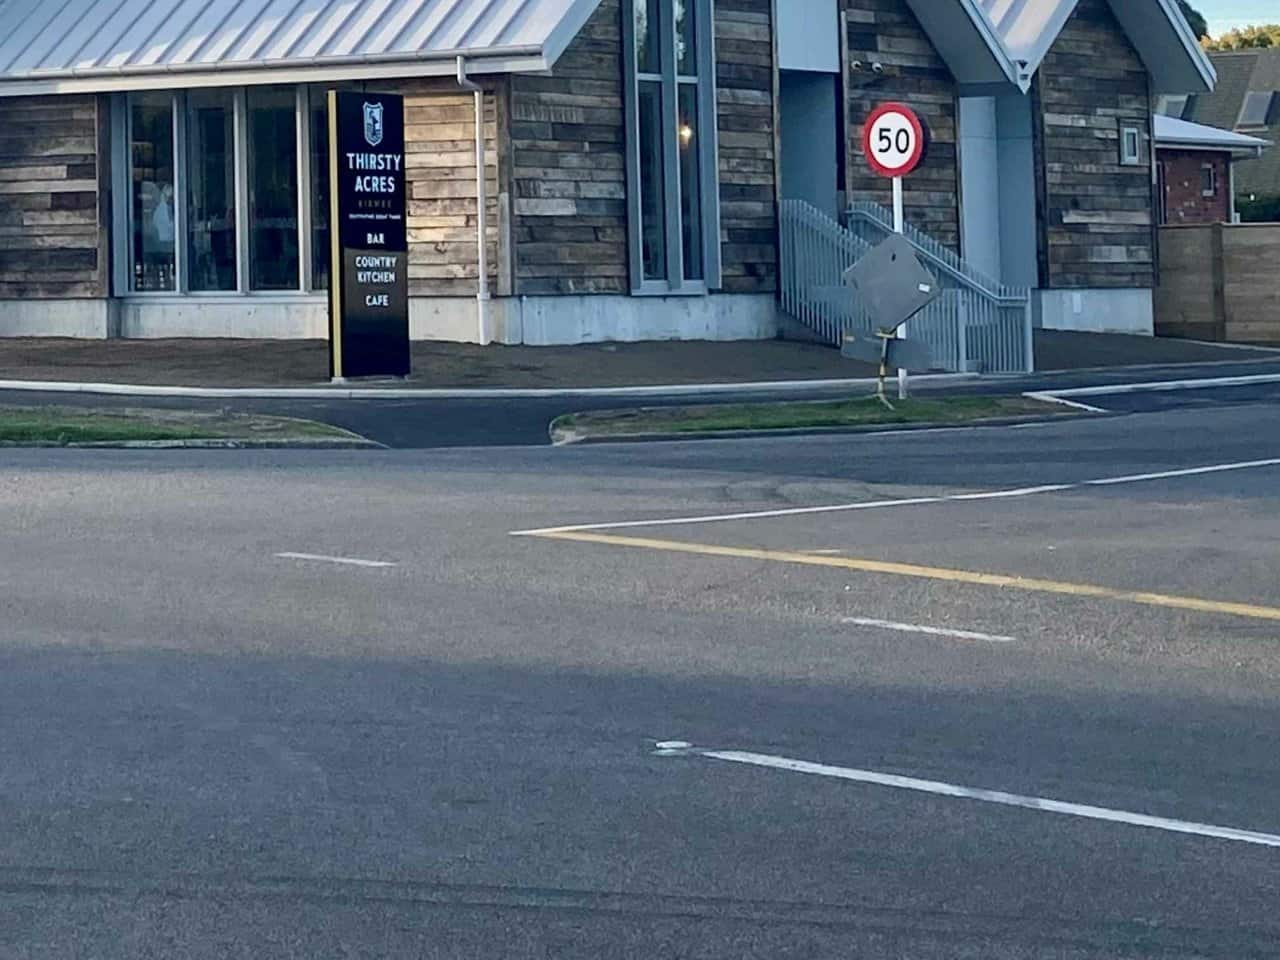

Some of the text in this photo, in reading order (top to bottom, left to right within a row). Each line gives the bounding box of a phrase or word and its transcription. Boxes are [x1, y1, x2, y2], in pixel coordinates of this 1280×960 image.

[878, 128, 910, 154] 50
[346, 152, 401, 171] THIRSTY
[355, 175, 395, 192] ACRES
[367, 233, 385, 244] BAR
[355, 256, 397, 268] COUNTRY
[357, 271, 396, 283] KITCHEN
[365, 295, 389, 306] CAFE
